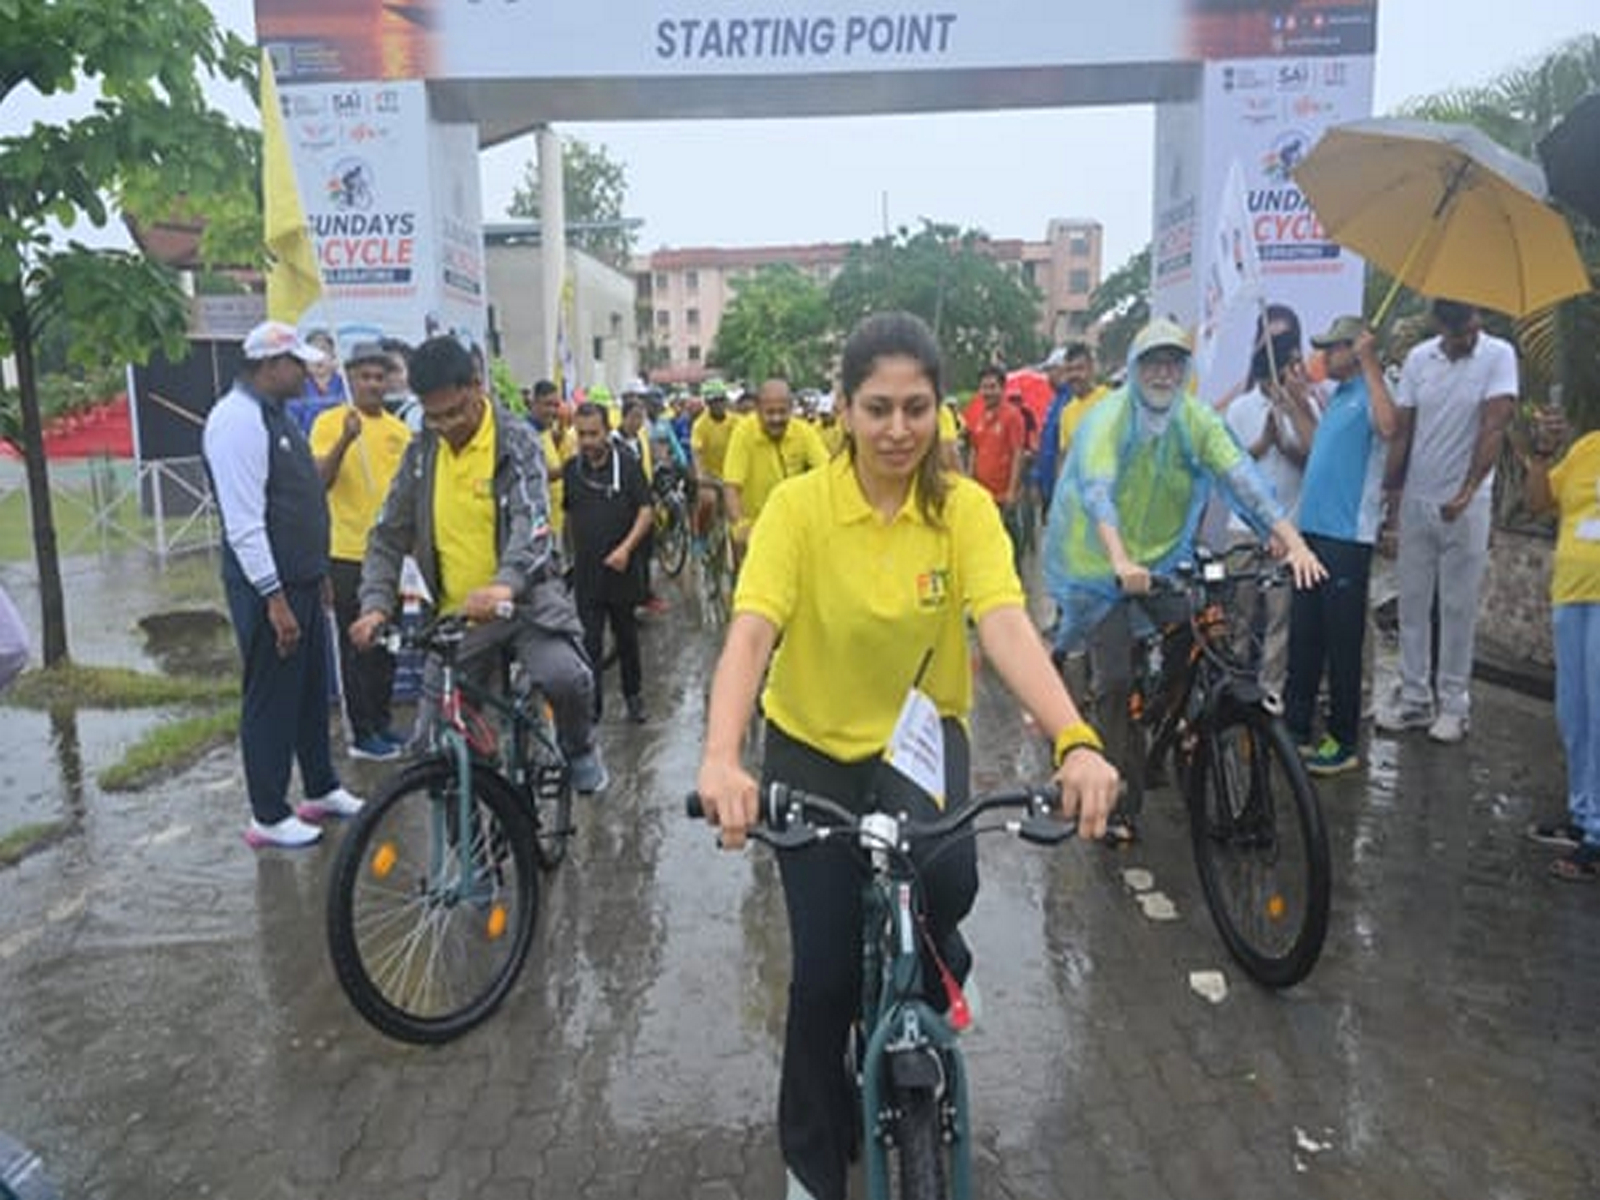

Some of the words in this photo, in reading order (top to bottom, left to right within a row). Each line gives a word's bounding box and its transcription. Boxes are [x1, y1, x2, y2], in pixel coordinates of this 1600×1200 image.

[656, 18, 836, 58] STARTING
[845, 13, 957, 53] POINT
[323, 237, 414, 267] CYCLE
